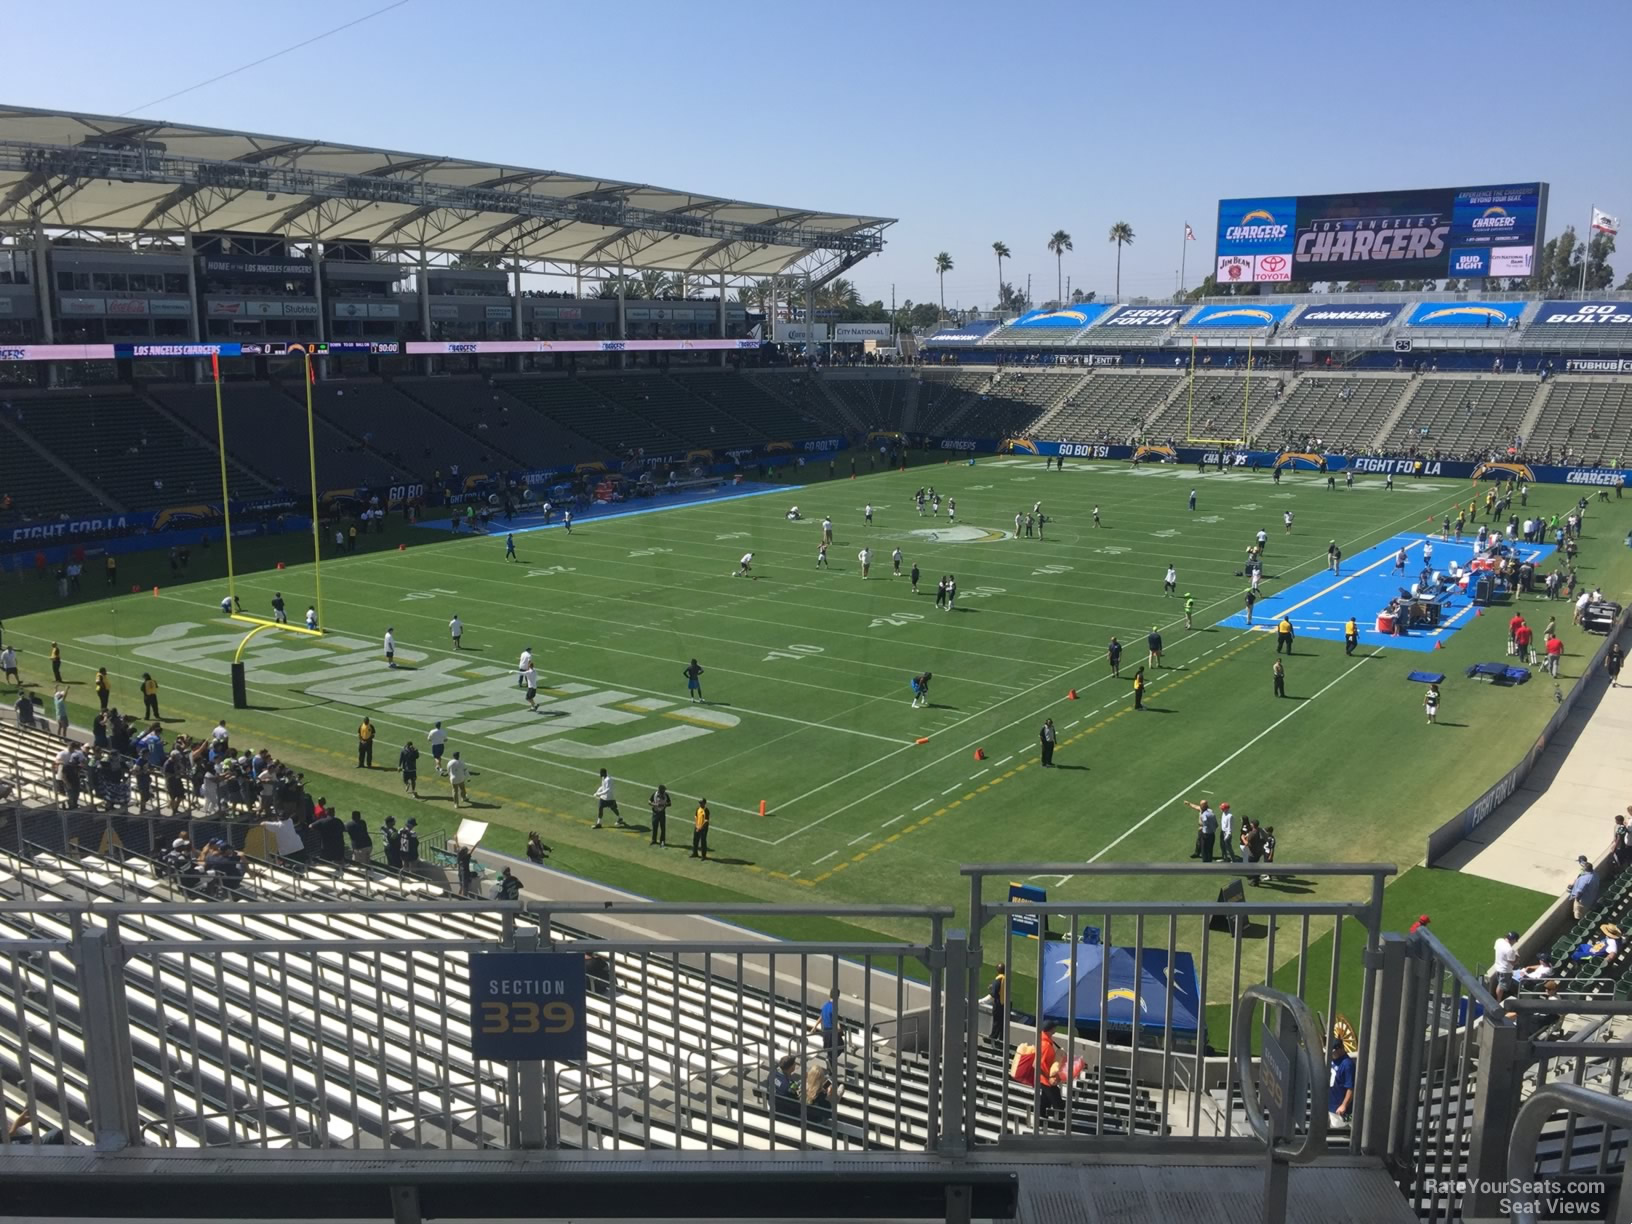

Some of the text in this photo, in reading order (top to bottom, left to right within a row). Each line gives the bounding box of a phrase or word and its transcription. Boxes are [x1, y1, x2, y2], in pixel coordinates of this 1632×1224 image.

[1312, 217, 1439, 231] LOS ANGELES
[1472, 216, 1516, 228] CHARGERS
[1226, 224, 1289, 240] CHARGERS
[1296, 226, 1450, 262] CHARGERS
[208, 261, 230, 271] HOME
[245, 263, 256, 273] LOS
[257, 263, 282, 273] ANGELES
[283, 265, 313, 274] CHARGERS
[1456, 262, 1484, 270] LIGHT
[1255, 273, 1290, 281] TOYOTA
[285, 305, 316, 314] StubHub
[1120, 309, 1183, 317] FIGHT
[1578, 305, 1617, 314] GO
[1107, 317, 1174, 325] FOR LA
[788, 330, 814, 340] Coro
[133, 345, 221, 355] LOS ANGELES CHARGERS
[1396, 341, 1409, 350] 25
[0, 349, 25, 360] GERS
[1059, 444, 1109, 457] GO BOTS!
[1354, 458, 1395, 472] FIGHT
[1424, 462, 1441, 475] LA
[1566, 472, 1627, 486] CHARGERS
[389, 487, 405, 500] GO
[13, 524, 66, 543] FIGHT
[399, 588, 458, 602] 10
[957, 586, 1007, 599] 30
[867, 612, 925, 628] 20
[762, 644, 825, 662] 10
[1471, 772, 1518, 828] FIGHT FOR LA
[489, 980, 565, 995] SECTION
[481, 1001, 575, 1033] 339
